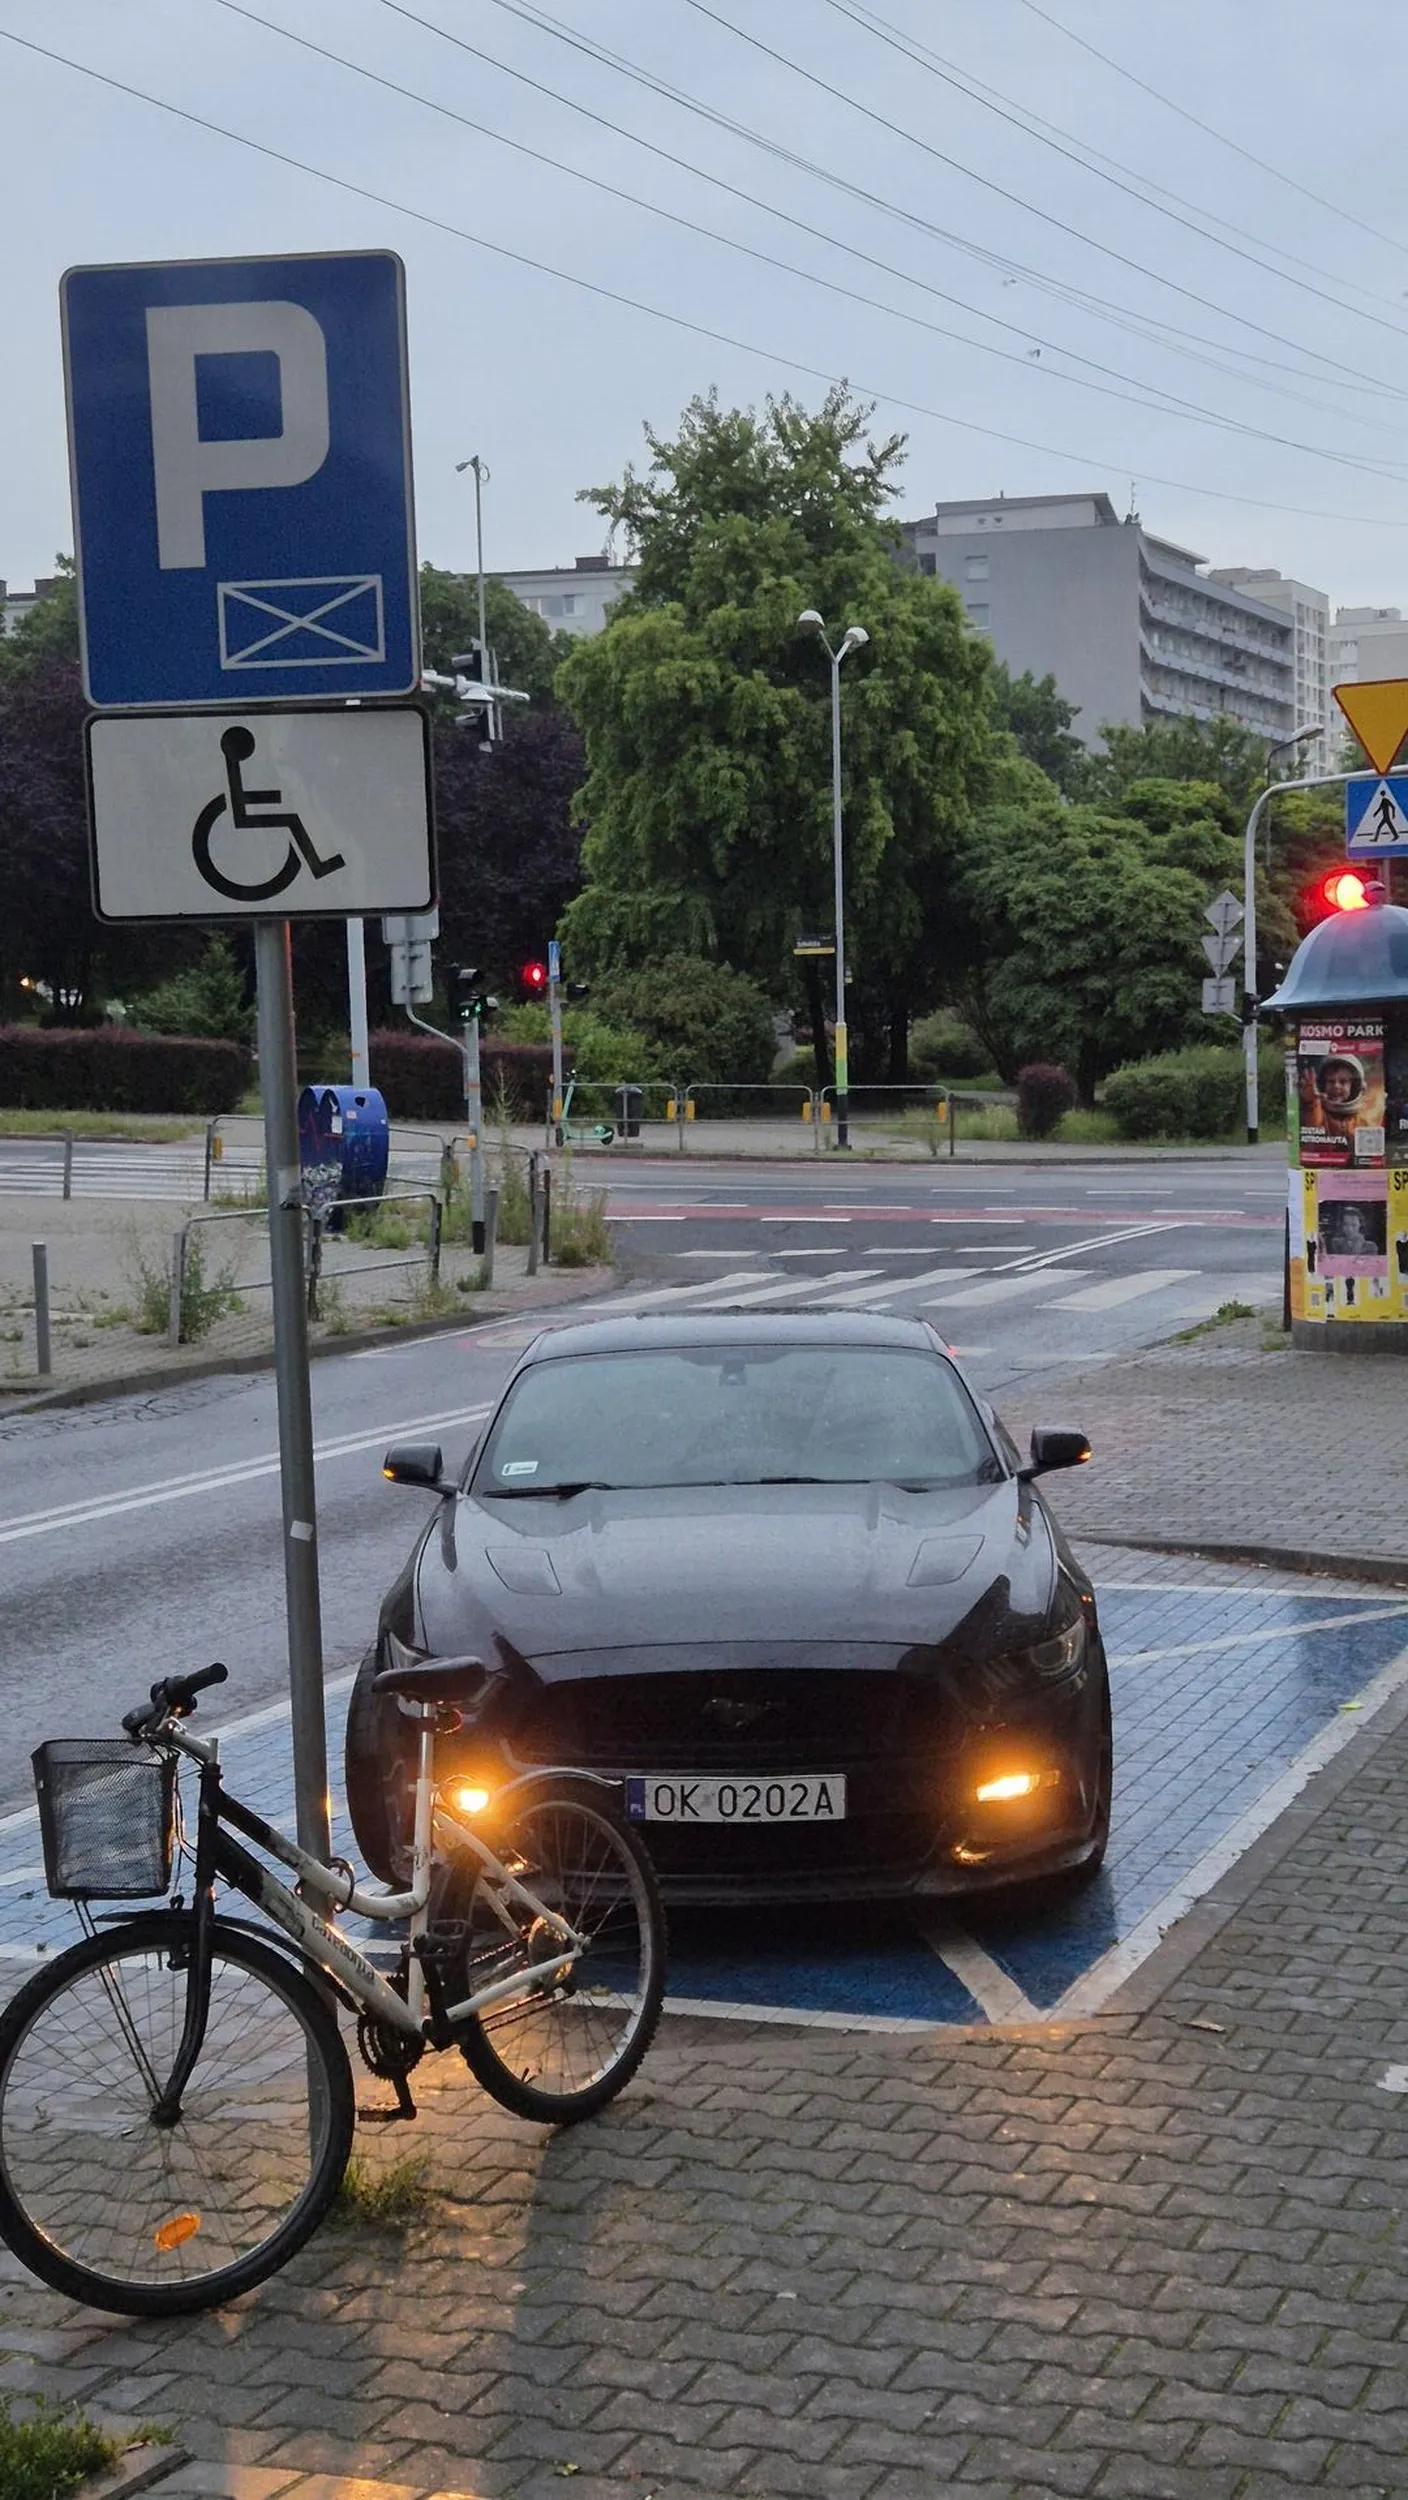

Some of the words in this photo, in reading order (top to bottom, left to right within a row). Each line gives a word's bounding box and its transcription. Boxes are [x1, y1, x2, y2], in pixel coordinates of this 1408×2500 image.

[145, 299, 330, 571] P
[1300, 1024, 1344, 1037] KOSMO
[1346, 1023, 1384, 1037] PARK
[654, 1783, 700, 1817] OK
[717, 1782, 834, 1818] 0202A
